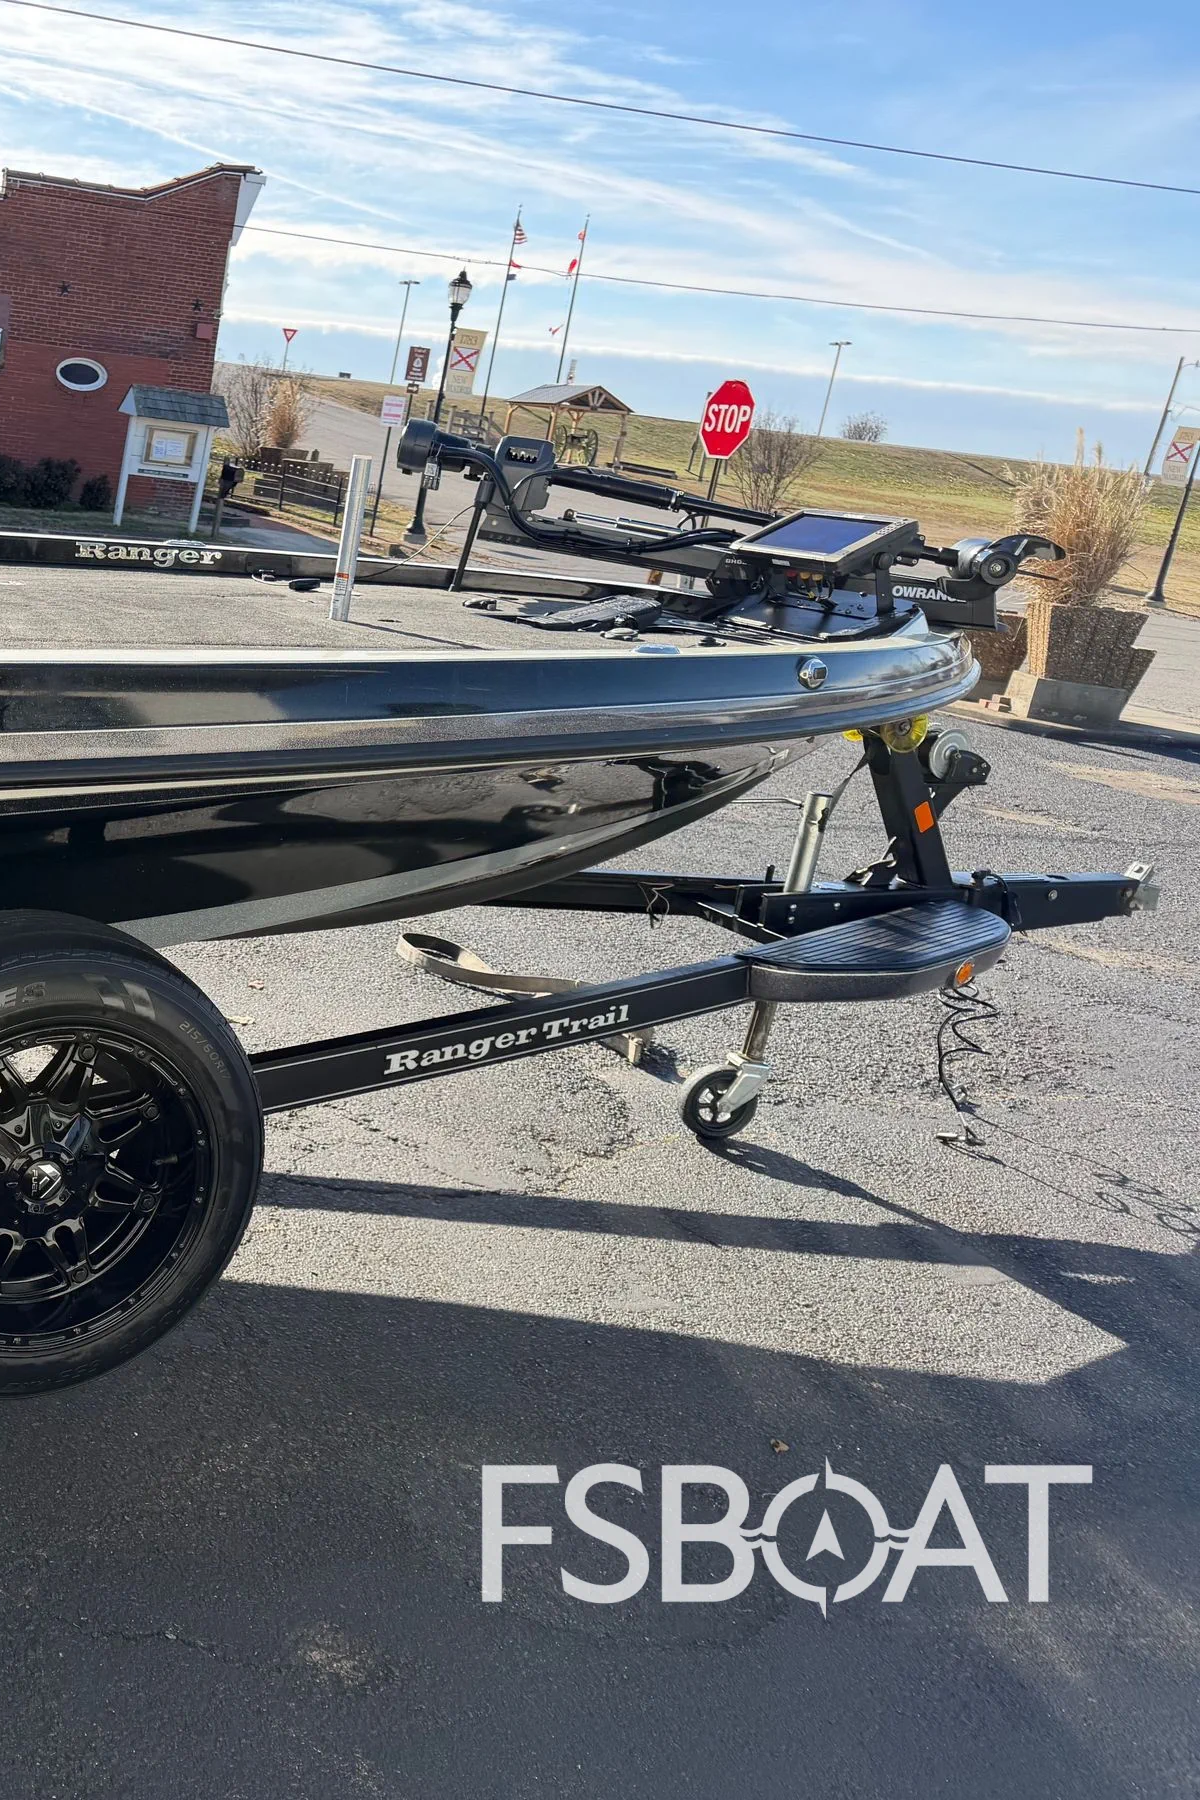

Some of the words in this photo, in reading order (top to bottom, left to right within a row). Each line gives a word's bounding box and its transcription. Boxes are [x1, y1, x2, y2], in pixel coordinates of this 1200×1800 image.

[704, 403, 751, 433] STOP
[75, 541, 222, 568] Ranger
[725, 558, 751, 566] GHO
[892, 585, 967, 602] OWRAN
[383, 1027, 537, 1076] Ranger
[542, 1004, 629, 1041] Trail
